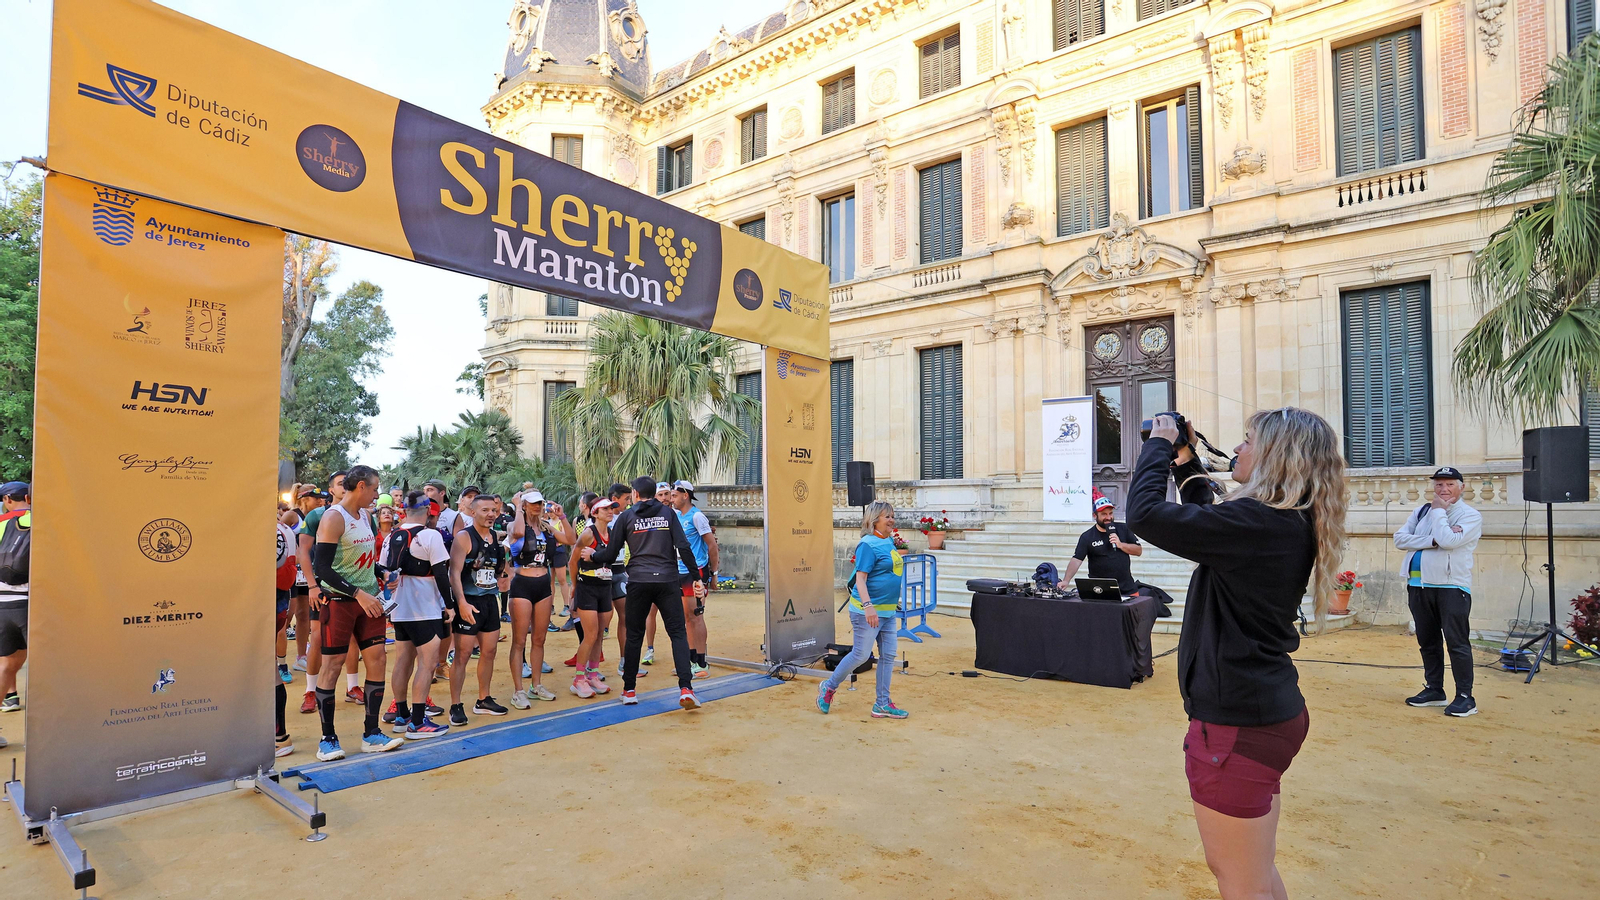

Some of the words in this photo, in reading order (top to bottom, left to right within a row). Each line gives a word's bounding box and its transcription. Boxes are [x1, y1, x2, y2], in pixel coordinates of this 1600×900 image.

[167, 83, 268, 131] Diputación
[166, 109, 190, 129] de
[199, 118, 251, 148] Cádiz
[303, 146, 359, 178] Sherry
[322, 164, 350, 178] Media
[145, 216, 250, 249] Ayuntamiento
[439, 141, 698, 303] Sherry
[145, 229, 164, 242] de
[167, 234, 206, 251] Jerez
[493, 227, 664, 307] Maratón
[186, 297, 227, 312] JEREZ
[793, 293, 826, 311] Diputación
[793, 307, 801, 316] de
[802, 309, 820, 321] Cádiz
[216, 316, 227, 345] WINES
[185, 341, 226, 354] SHERRY
[130, 380, 208, 406] HSN
[121, 403, 138, 411] WE
[141, 405, 161, 413] ARE
[163, 407, 215, 417] NUTRITION!
[790, 446, 812, 459] HSN
